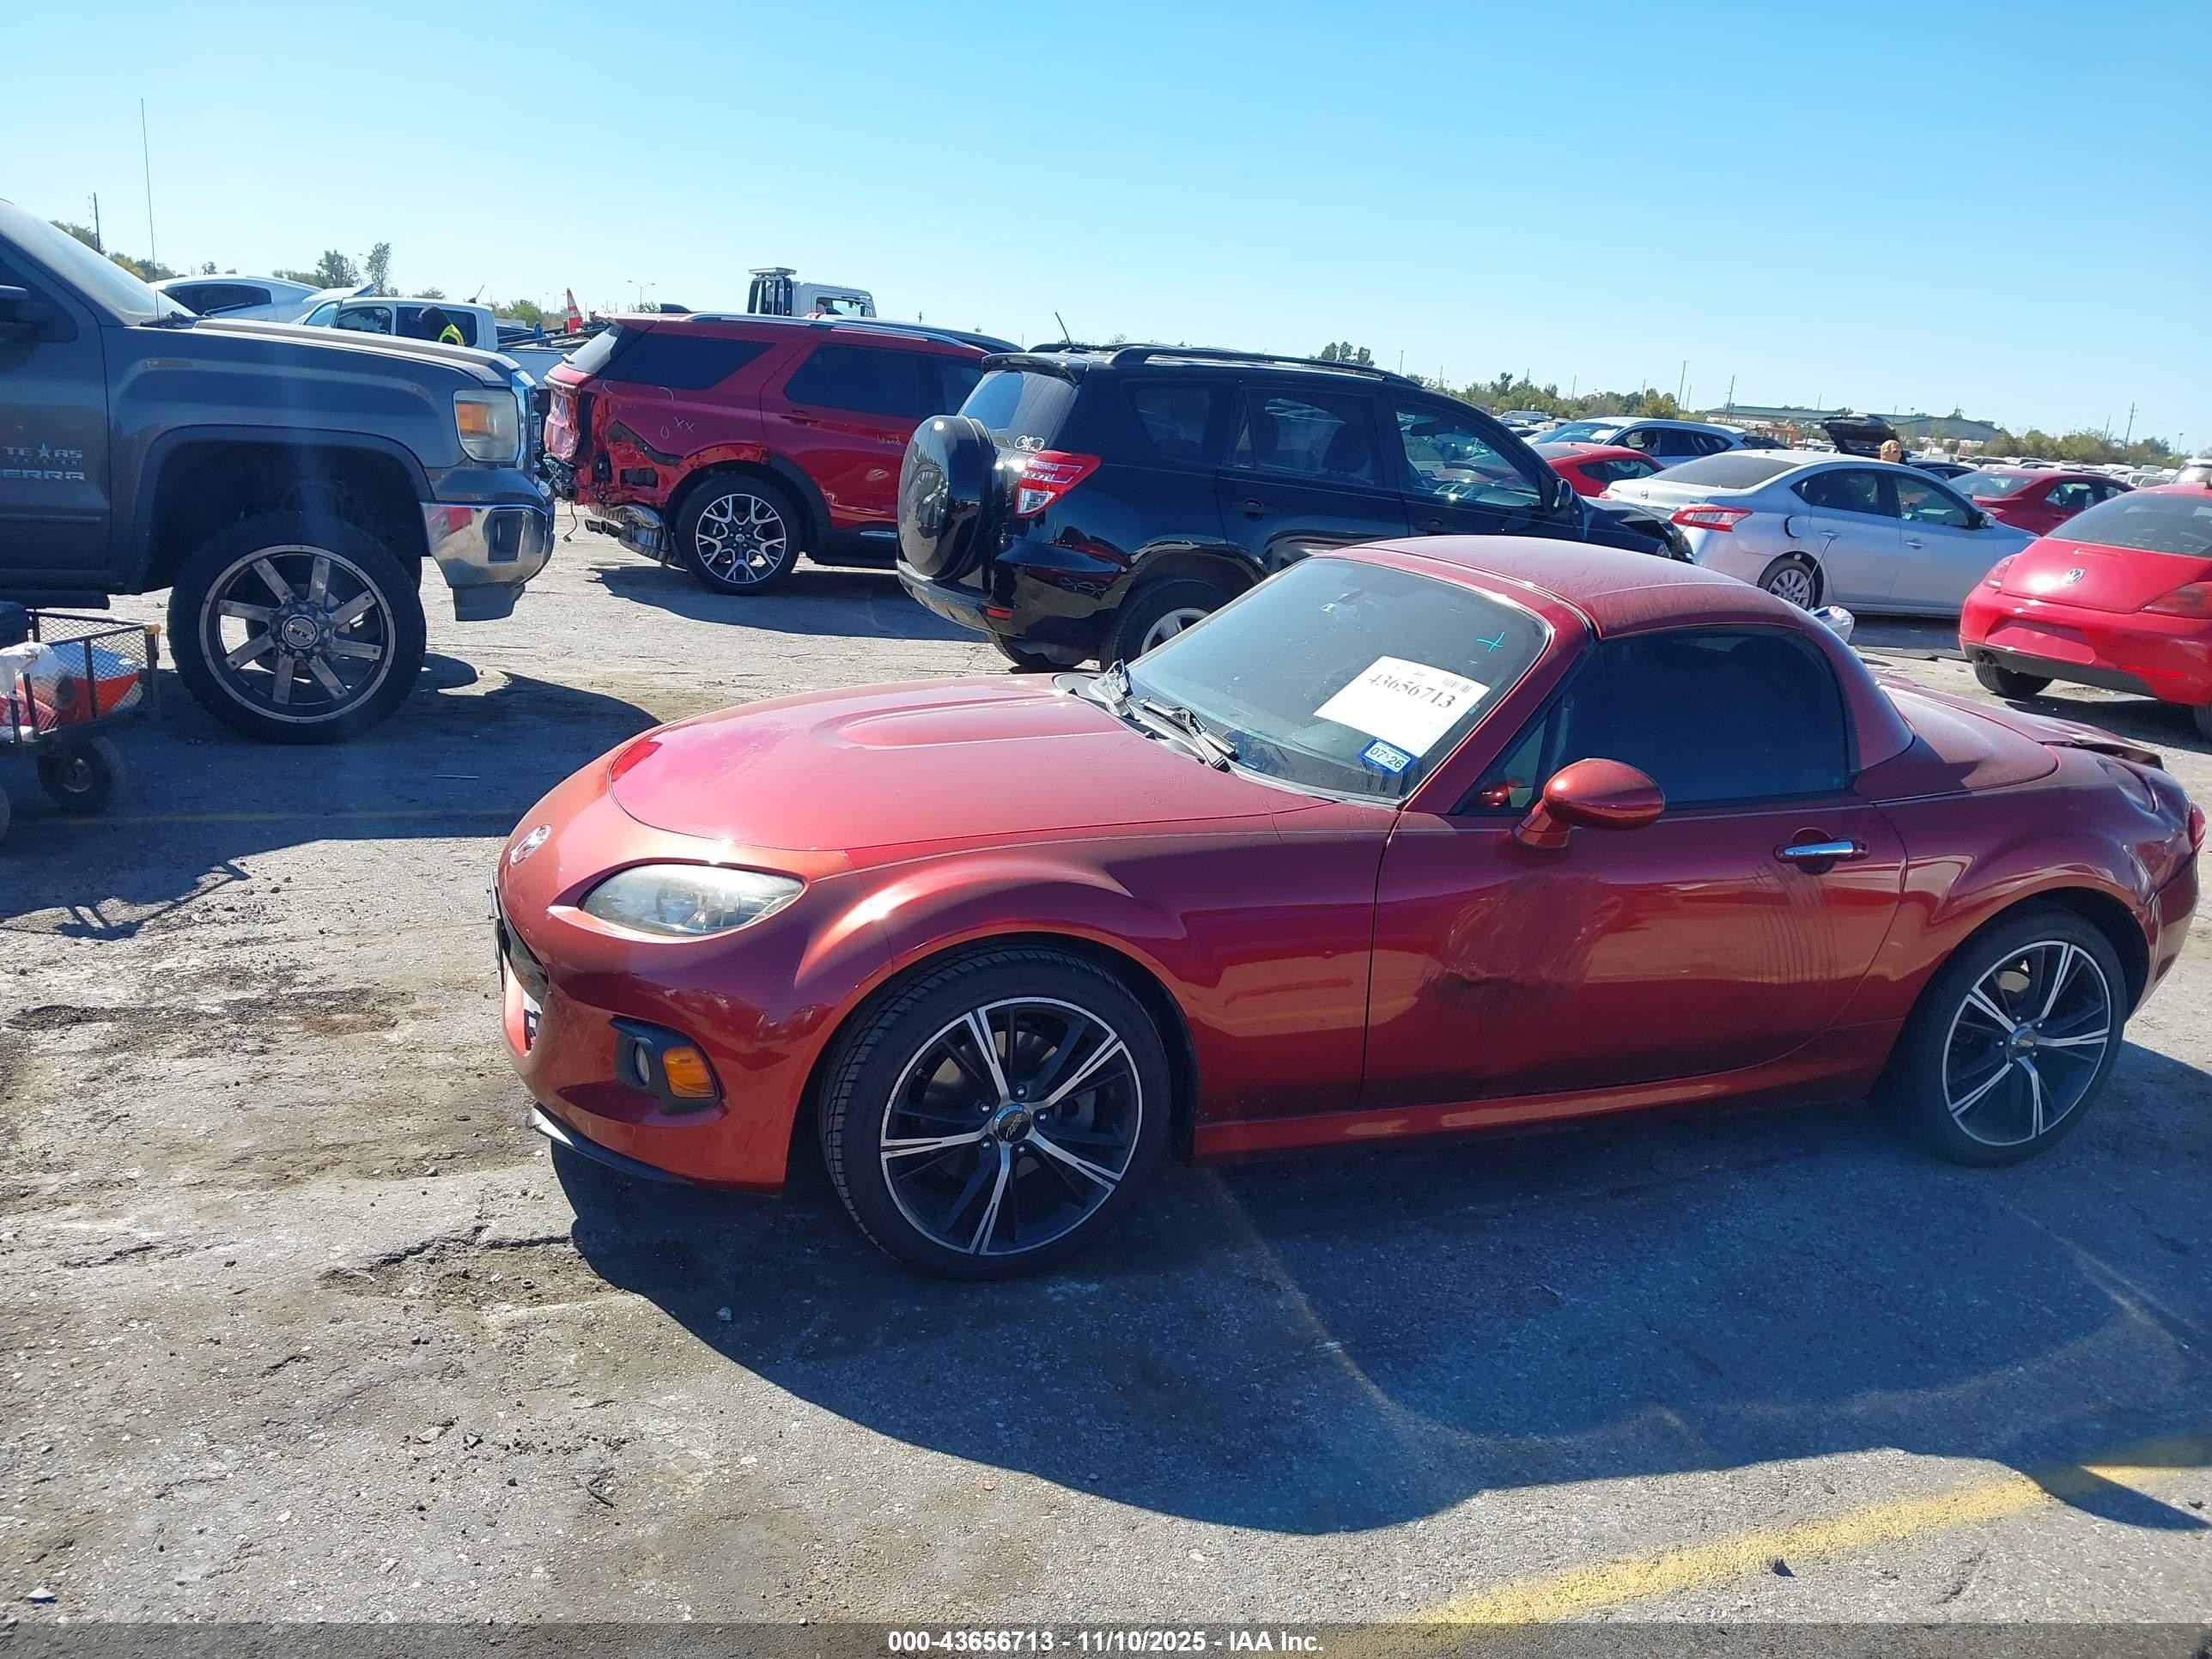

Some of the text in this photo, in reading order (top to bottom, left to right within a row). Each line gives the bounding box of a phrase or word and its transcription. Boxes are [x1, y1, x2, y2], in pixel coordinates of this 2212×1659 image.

[0, 469, 85, 481] ERRA
[1368, 674, 1456, 708] 43656713
[1370, 747, 1404, 769] 07 26
